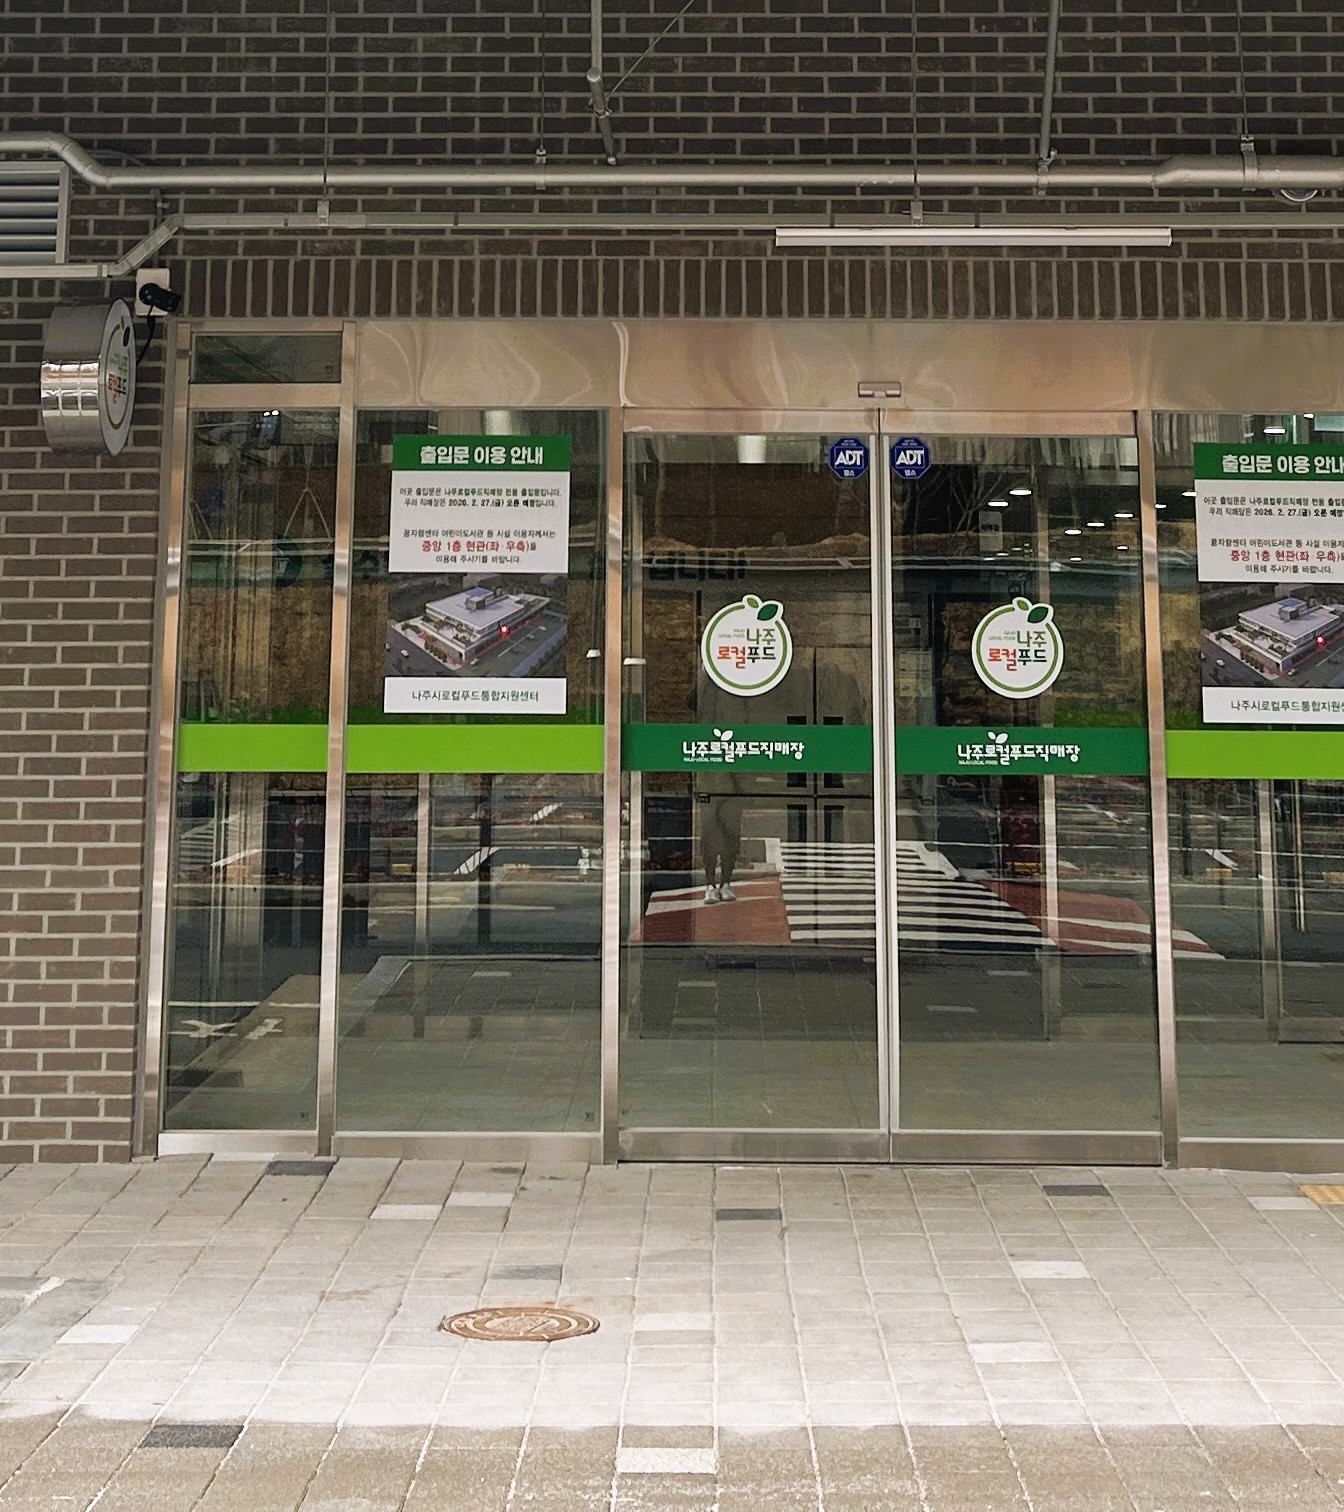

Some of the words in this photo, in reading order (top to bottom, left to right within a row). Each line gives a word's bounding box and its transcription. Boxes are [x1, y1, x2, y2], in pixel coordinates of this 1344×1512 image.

[419, 445, 470, 465] 출입문
[473, 446, 507, 465] 이용
[510, 446, 544, 465] 안내
[834, 449, 865, 466] ADT
[895, 449, 925, 466] ADT
[1221, 454, 1273, 474] 출입문
[1276, 455, 1311, 474] 이용
[746, 627, 777, 646] 나주
[1016, 630, 1048, 648] 나주
[716, 645, 777, 670] 로컬푸드
[987, 648, 1048, 672] 로컬푸드
[682, 740, 805, 763] 나주로컬푸드직매장
[957, 744, 1081, 766] 나주로컬푸드직매장
